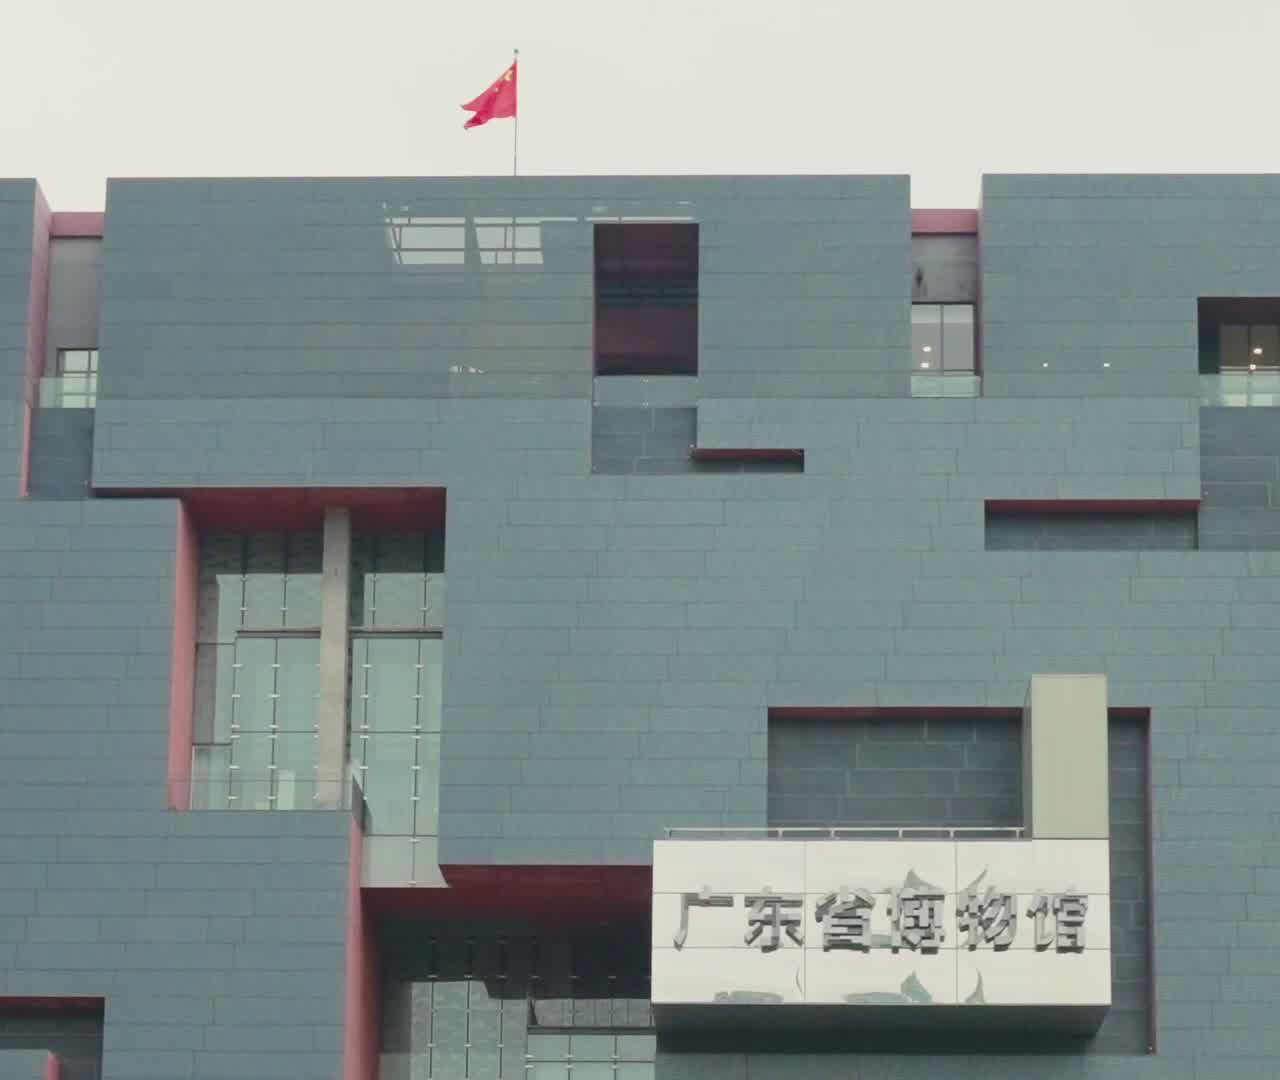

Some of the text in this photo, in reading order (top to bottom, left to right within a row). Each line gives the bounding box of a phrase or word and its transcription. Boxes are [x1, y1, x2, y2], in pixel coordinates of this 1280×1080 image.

[673, 887, 1089, 954] 广东省博物馆
